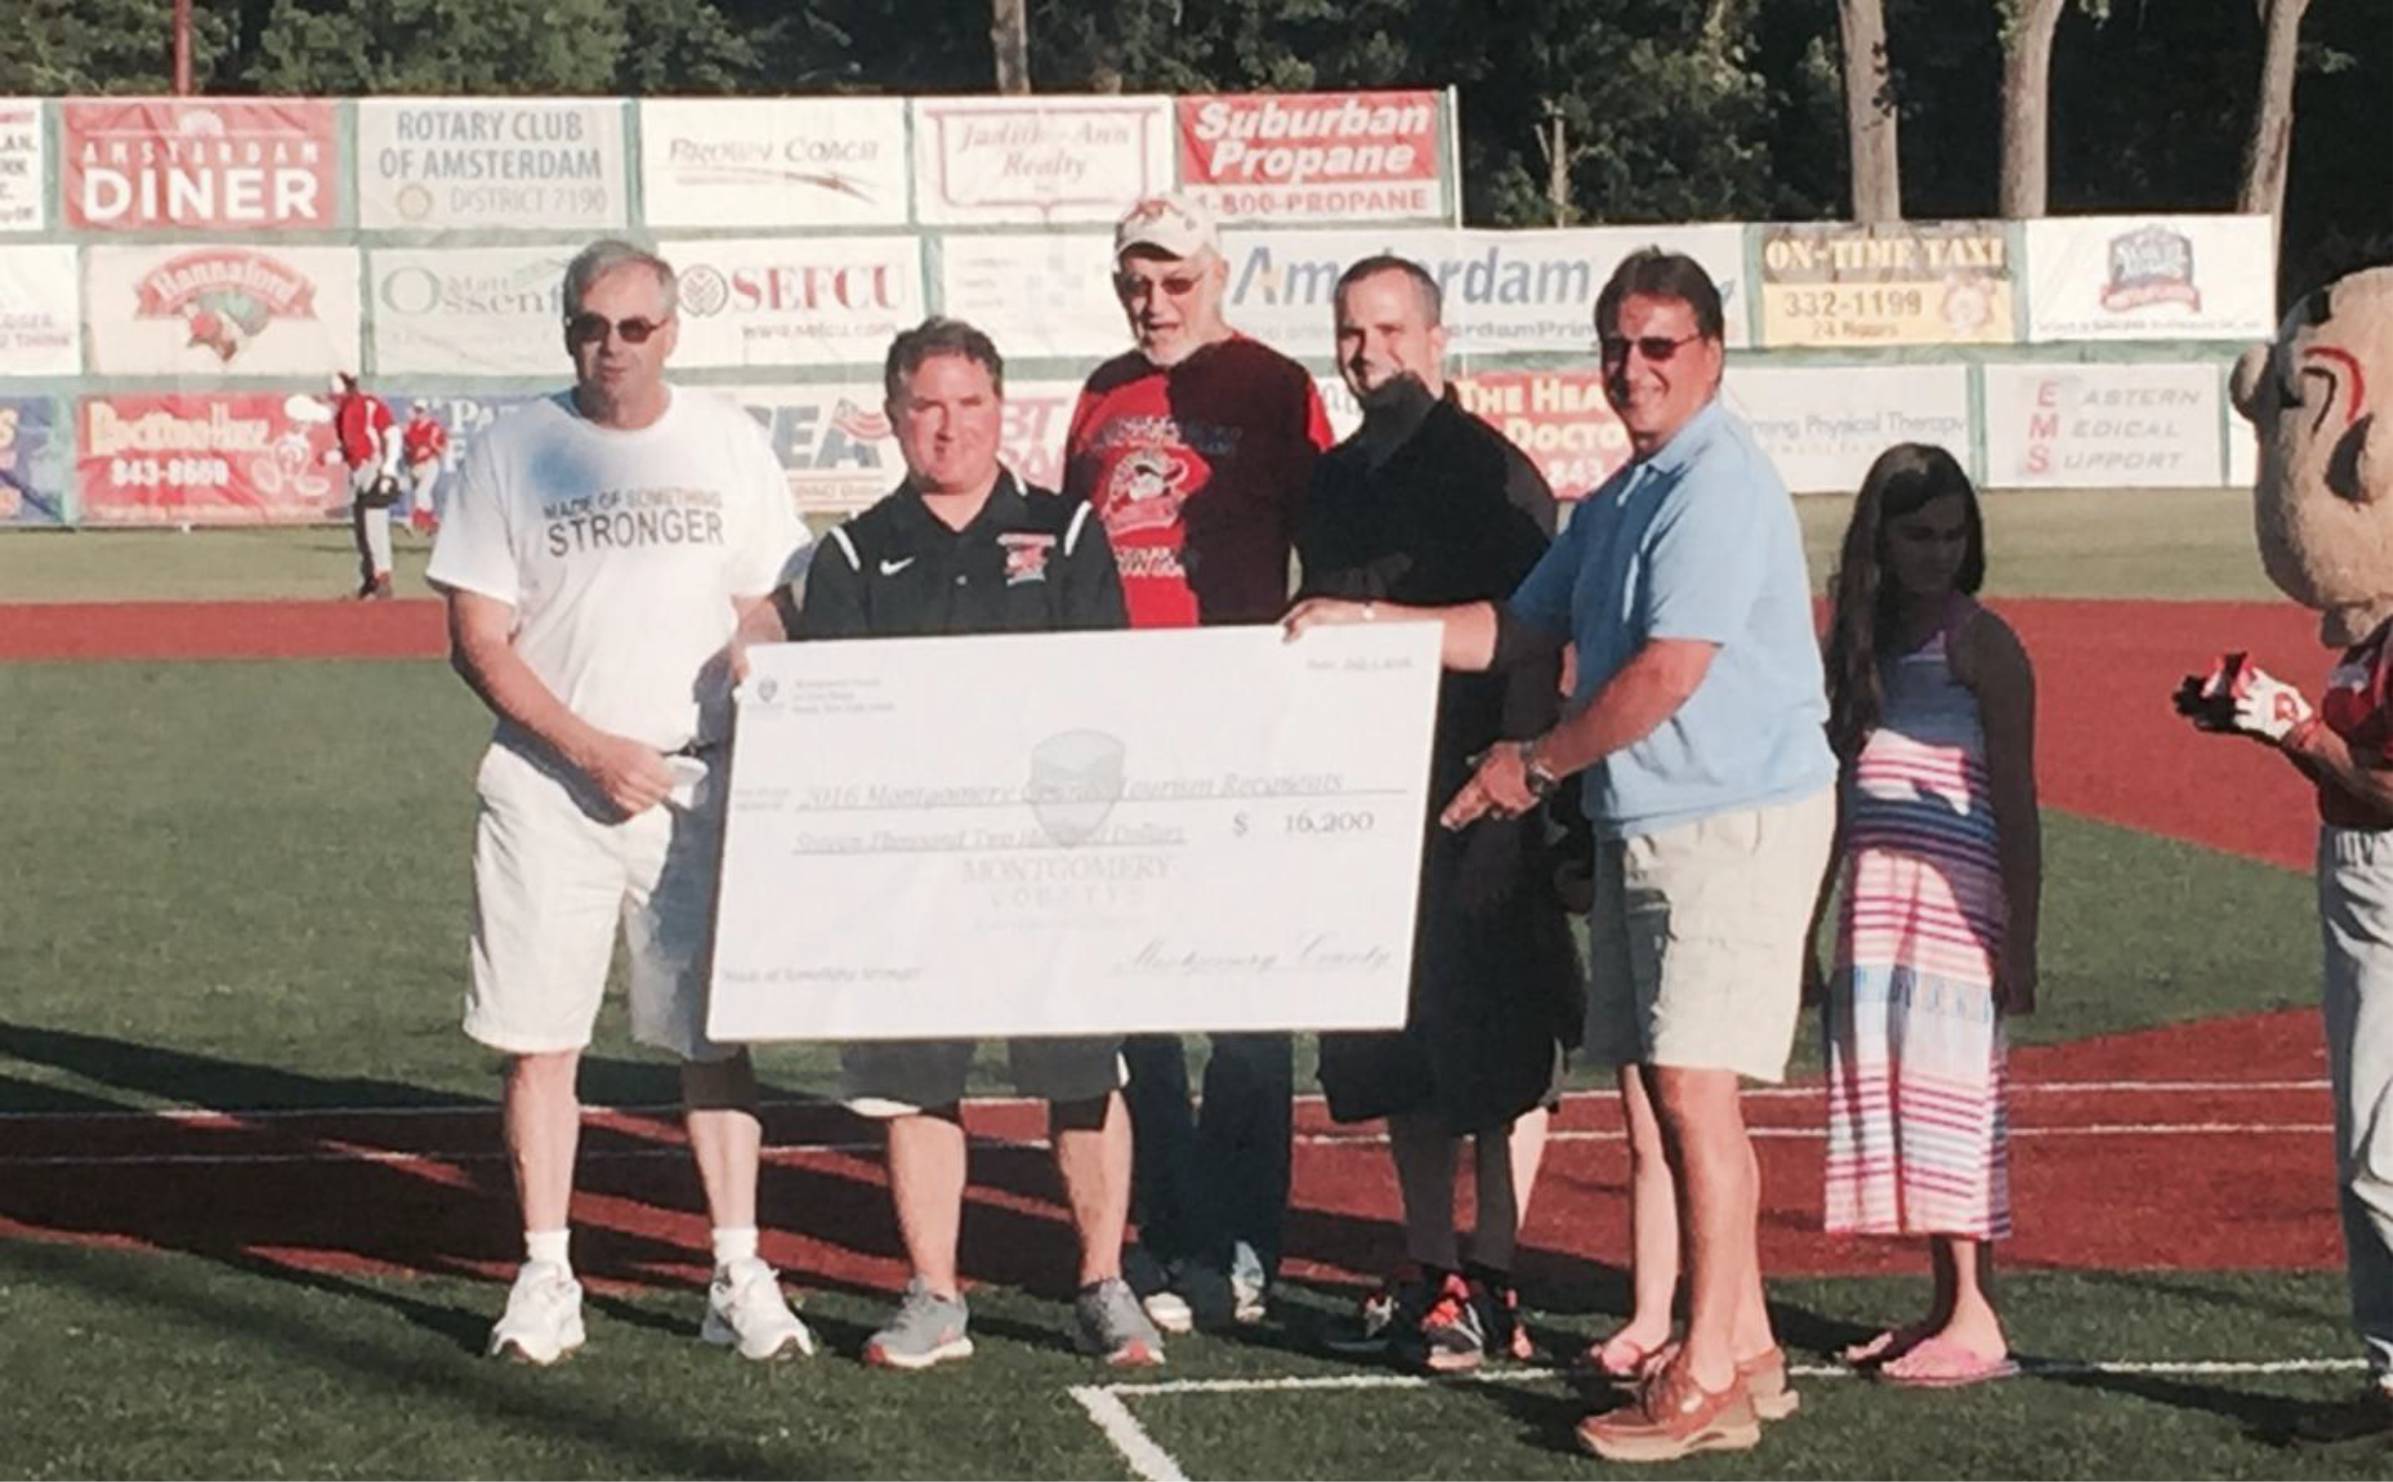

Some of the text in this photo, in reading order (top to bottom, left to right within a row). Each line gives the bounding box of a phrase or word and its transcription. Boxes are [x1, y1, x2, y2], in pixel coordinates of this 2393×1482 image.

[396, 110, 584, 141] ROTARY CLUB
[1193, 96, 1430, 140] Suburban
[82, 141, 320, 164] AMSTERDAM
[379, 147, 604, 180] OF AMSTERDAM
[1002, 150, 1087, 184] Realty
[1209, 140, 1416, 189] Propane
[83, 167, 319, 221] DINER
[450, 186, 545, 214] DISTRICT
[1924, 235, 2004, 267] TAXI
[151, 257, 299, 305] Hannaford
[731, 264, 905, 311] SEFCU
[1784, 288, 1922, 318] 332-1199
[1456, 374, 1609, 415] THE HEA
[1503, 416, 1628, 453] DOCTO
[1888, 410, 1966, 437] Therapy
[547, 508, 724, 559] STRONGER
[1232, 812, 1250, 838] $
[961, 855, 1174, 883] MONTGOMERY
